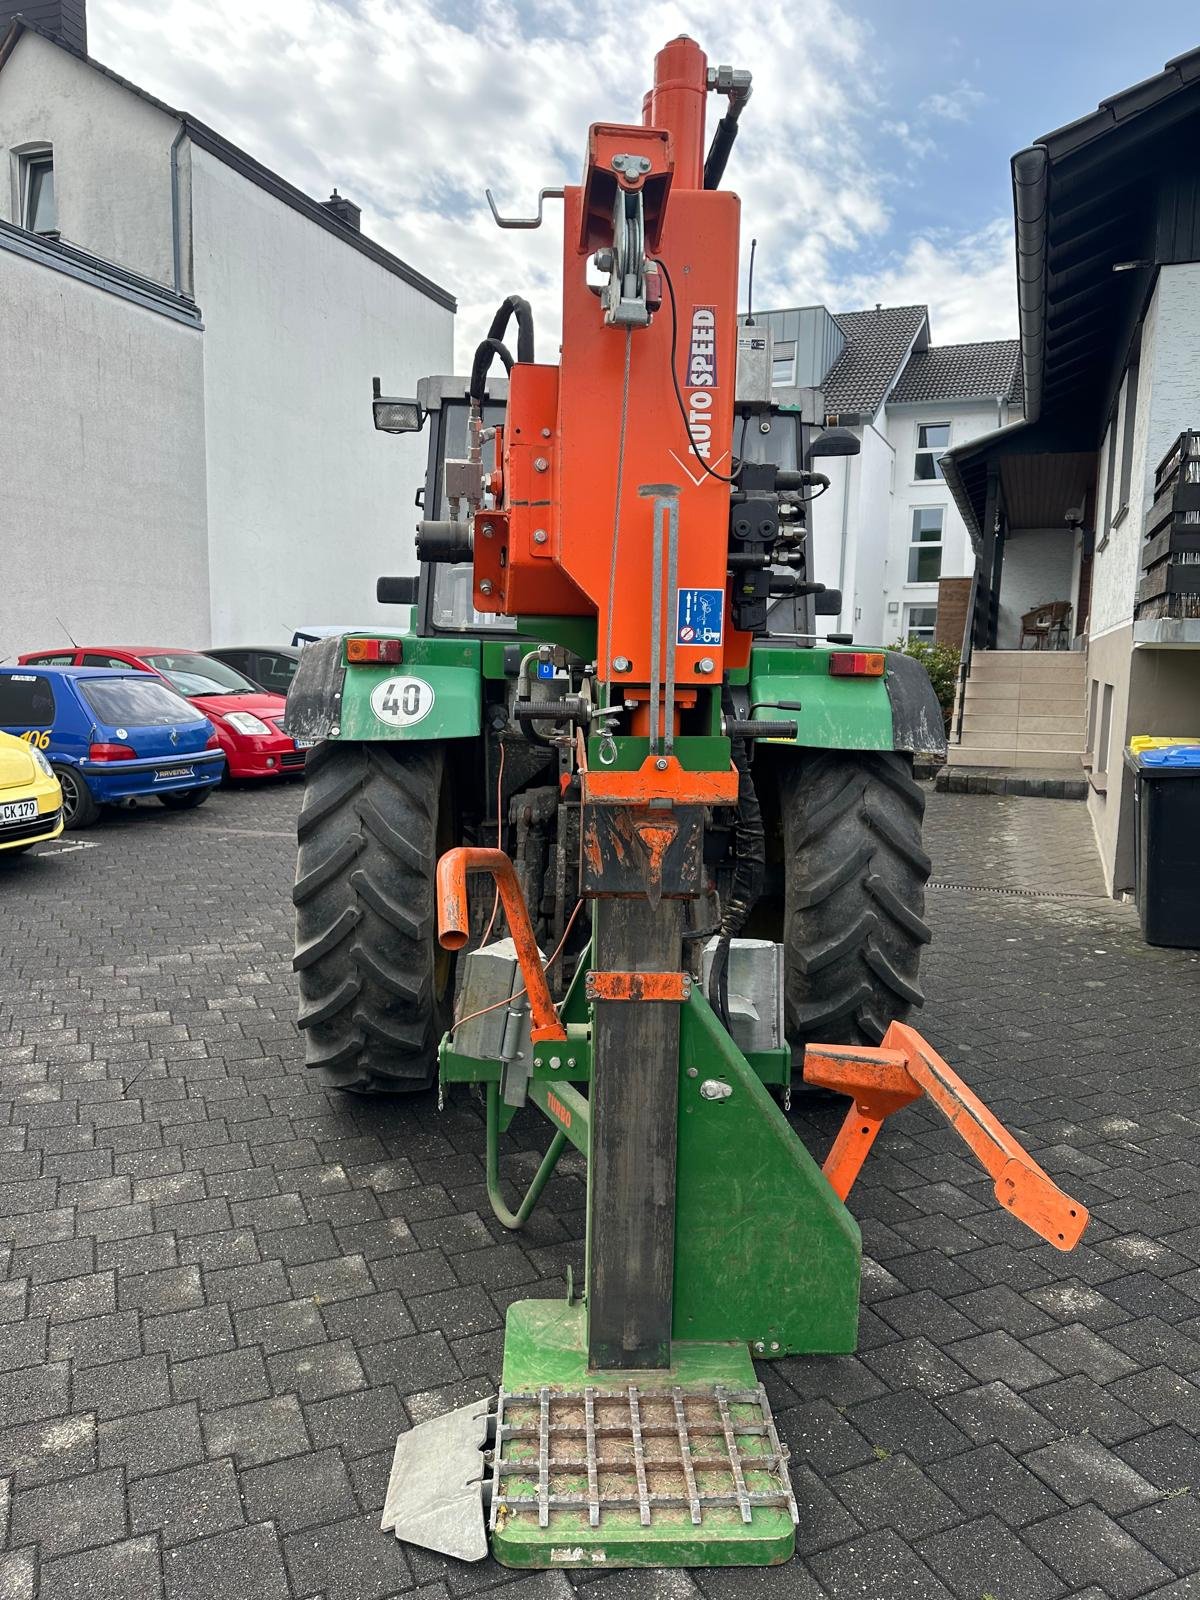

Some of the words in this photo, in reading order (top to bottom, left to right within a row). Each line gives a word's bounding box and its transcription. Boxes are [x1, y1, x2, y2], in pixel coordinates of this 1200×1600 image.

[691, 309, 715, 386] SPEED
[688, 391, 712, 458] AUTO
[382, 684, 421, 716] 40
[4, 805, 17, 819] CK
[18, 802, 35, 817] 179
[547, 1091, 572, 1129] TURBO
